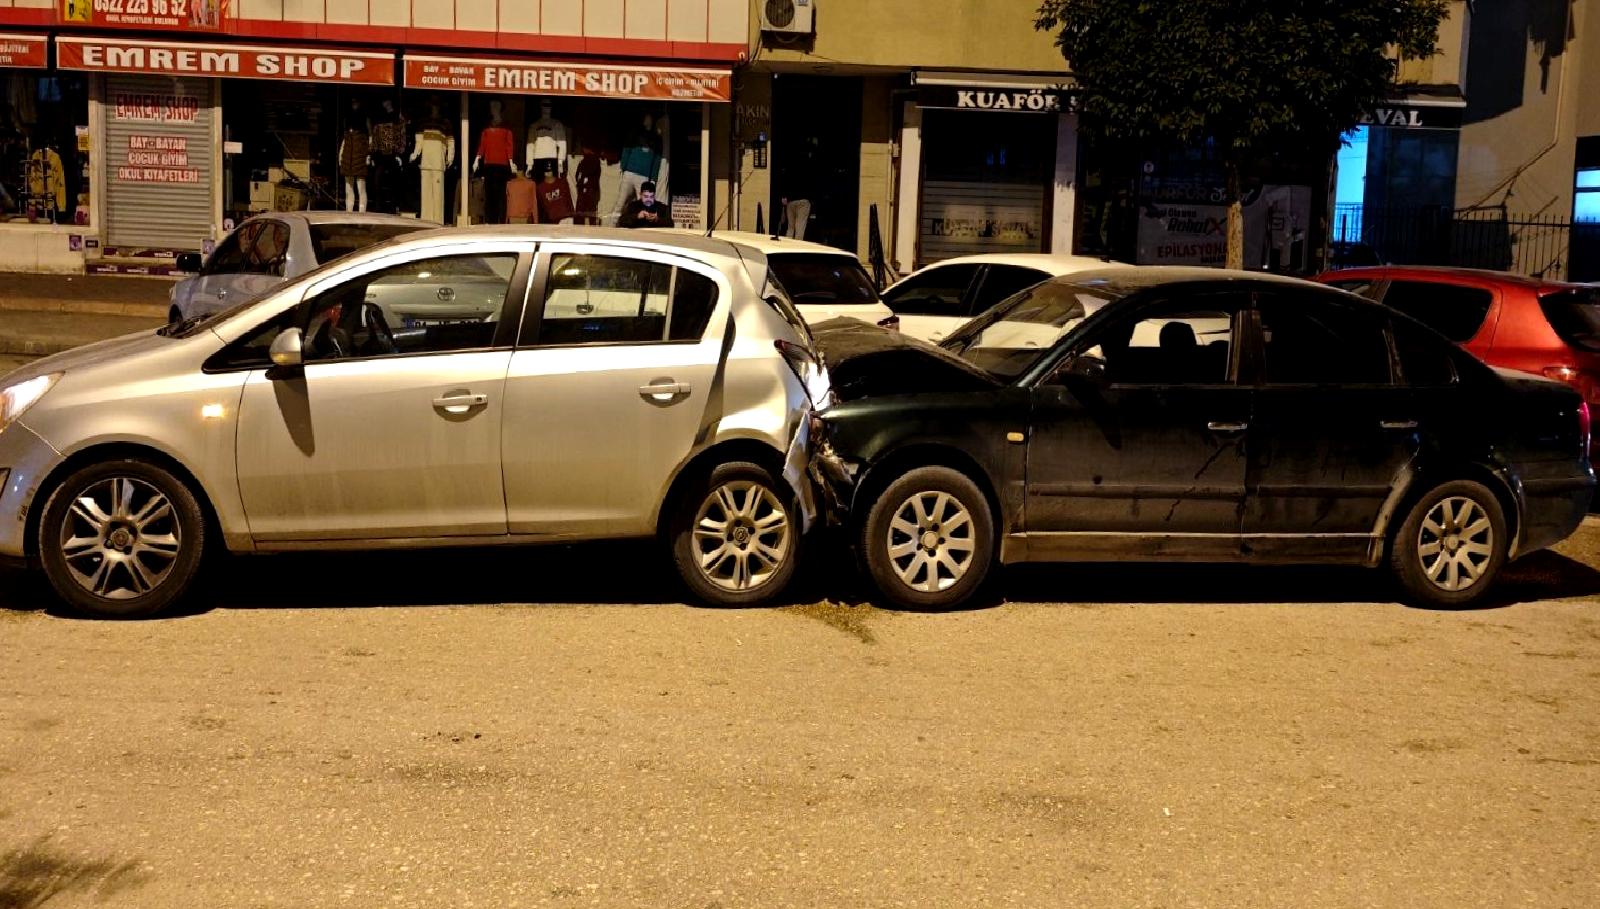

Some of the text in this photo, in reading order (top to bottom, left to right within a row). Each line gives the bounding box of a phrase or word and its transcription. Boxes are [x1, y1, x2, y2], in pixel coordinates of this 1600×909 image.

[83, 45, 366, 79] EMREM SHOP
[484, 67, 649, 94] EMREM SHOP
[115, 94, 198, 122] EMREM SHOP
[957, 90, 1061, 112] KUAFÖR
[130, 136, 147, 149] BAY
[155, 137, 186, 150] BAYAN
[119, 167, 142, 180] OKUL
